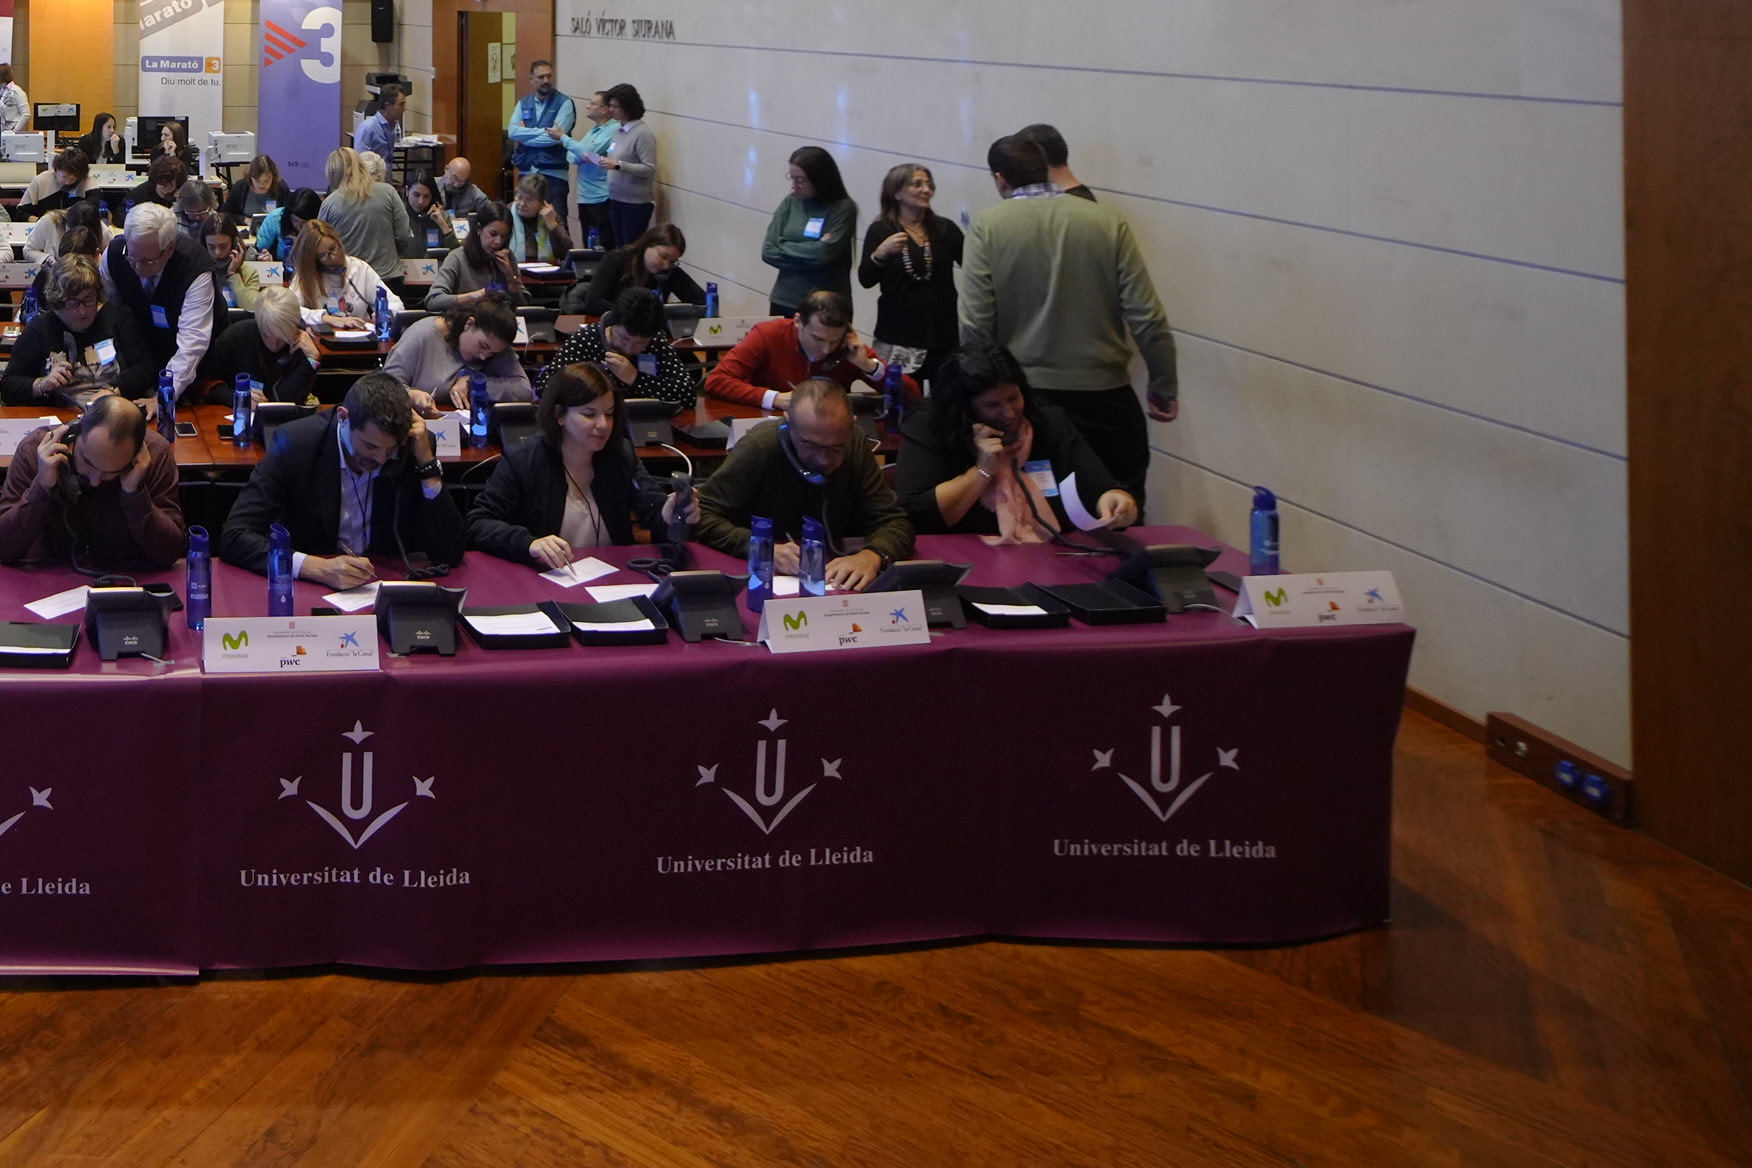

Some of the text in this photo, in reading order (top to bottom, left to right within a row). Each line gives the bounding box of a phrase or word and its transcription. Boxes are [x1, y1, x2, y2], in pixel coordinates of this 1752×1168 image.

[570, 10, 592, 35] SALÓ
[595, 10, 626, 38] VÍCTOR
[300, 6, 342, 83] 3
[145, 59, 220, 70] La Marató 3
[161, 77, 175, 85] Diu
[177, 77, 196, 85] molt
[198, 78, 208, 86] de
[838, 636, 858, 646] pwc
[280, 658, 301, 668] pwc
[1052, 839, 1277, 858] Universitat de Lleida
[657, 846, 874, 874] Universitat de Lleida
[20, 877, 90, 895] Lleida
[239, 866, 471, 888] Universitat de Lleida
